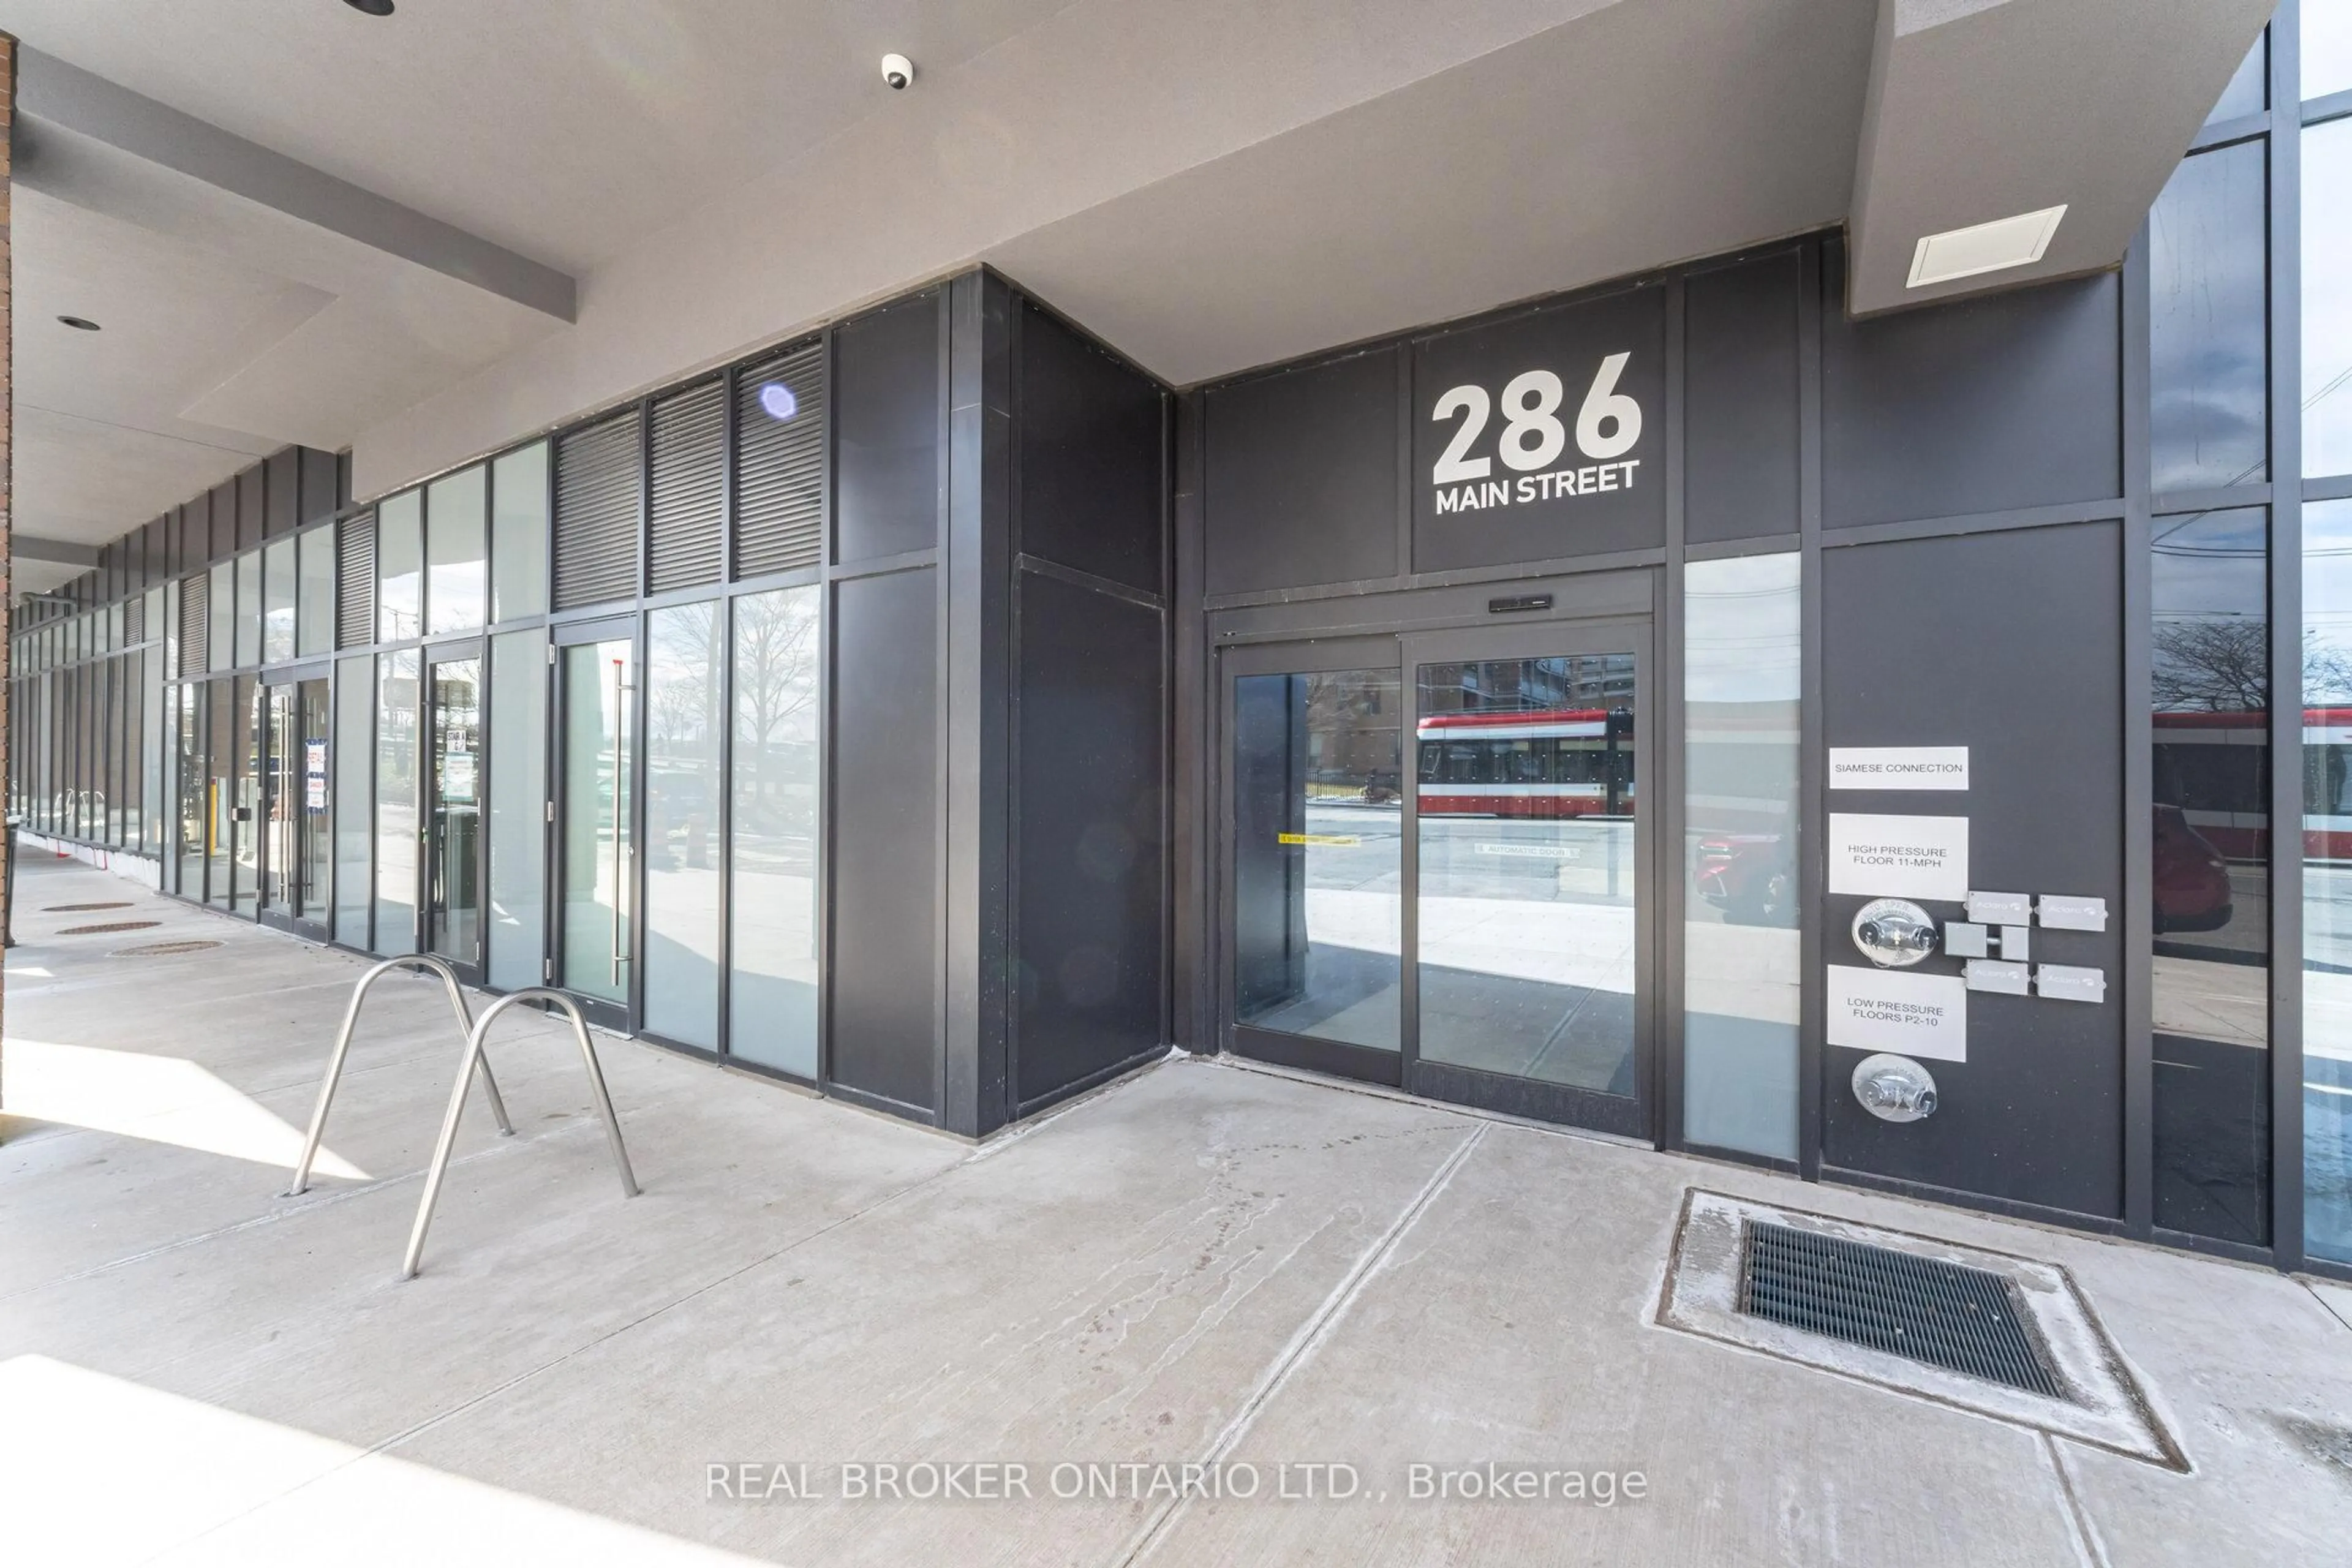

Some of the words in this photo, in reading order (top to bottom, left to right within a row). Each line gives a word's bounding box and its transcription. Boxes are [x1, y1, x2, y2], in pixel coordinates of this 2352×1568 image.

[1432, 352, 1642, 484] 286
[1437, 480, 1509, 514] MAIN
[1516, 460, 1640, 503] STREET
[1835, 764, 1883, 773] SIAMESE
[1886, 764, 1963, 773] CONNECTION
[1488, 846, 1536, 854] AUTOMATIC
[1848, 845, 1877, 855] HIGH
[1880, 846, 1947, 858] PRESSURE
[1853, 855, 1894, 866] FLOOR
[1898, 857, 1942, 869] 11-MPH
[1847, 998, 1874, 1009] LOW
[1877, 1001, 1944, 1017] PRESSURE
[1853, 1009, 1902, 1023] FLOORS
[1905, 1015, 1938, 1027] P2-10
